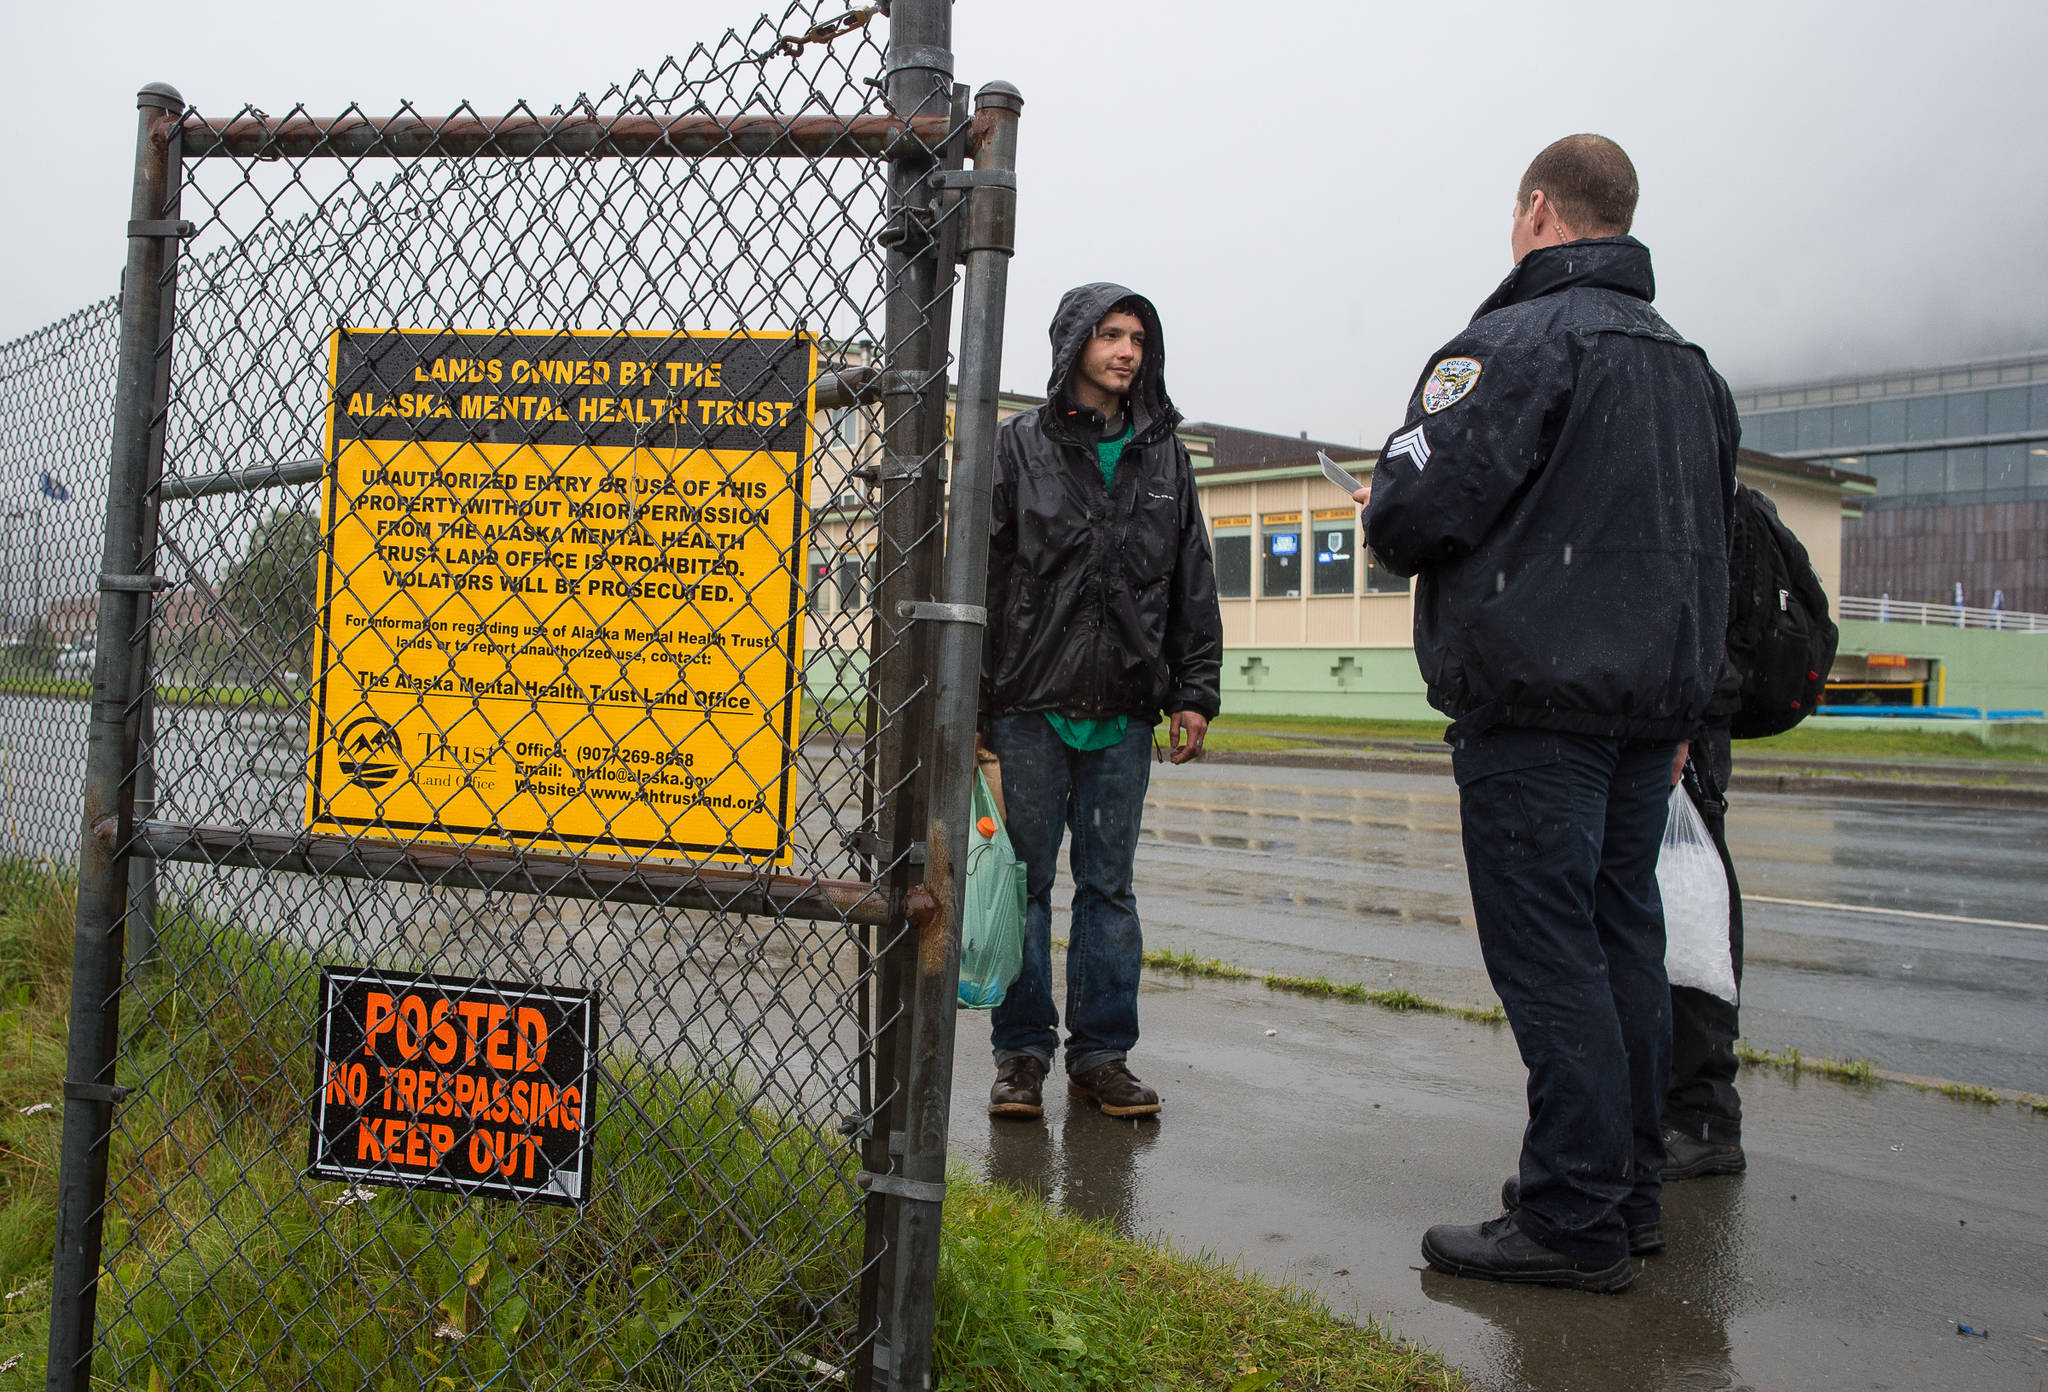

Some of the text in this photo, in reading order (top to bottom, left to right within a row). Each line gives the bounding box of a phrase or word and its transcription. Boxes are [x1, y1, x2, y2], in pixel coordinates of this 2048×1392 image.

[415, 358, 722, 387] LANDS OWNED BY THE
[1446, 360, 1472, 368] POLICE
[347, 392, 794, 427] ALASKA MENTAL HEALTH TRUST
[362, 469, 767, 499] UNAUTHORIZED ENTRY OR USE OF THIS
[357, 494, 770, 526] PROPERTY WITHOUT PRIOR PERMISSION
[377, 520, 745, 550] FROM THE ALASKA MENTAL HEALTH
[377, 545, 745, 577] TRUST LAND OFFICE IS PROHIBITED.
[383, 570, 734, 602] VIOLATORS WILL BE PROSECUTED.
[345, 614, 366, 627] For
[452, 621, 519, 638] regarding
[523, 625, 548, 636] use
[552, 624, 567, 637] of
[624, 628, 673, 643] Menal
[730, 633, 771, 648] Trust
[396, 635, 711, 665] lands or to report unauthorized use, contact:
[357, 670, 750, 710] The Alaska Mental Health Trust Land Office
[417, 732, 497, 766] Trust
[516, 742, 567, 759] Office:
[577, 745, 617, 766] (907)
[416, 772, 451, 787] Land
[515, 761, 715, 790] Email: mhtlo@alaska.gov
[515, 779, 583, 797] Website:
[364, 991, 548, 1073] POSTED
[326, 1061, 582, 1131] NO TRESPASSING
[357, 1116, 543, 1179] KEEP OUT
